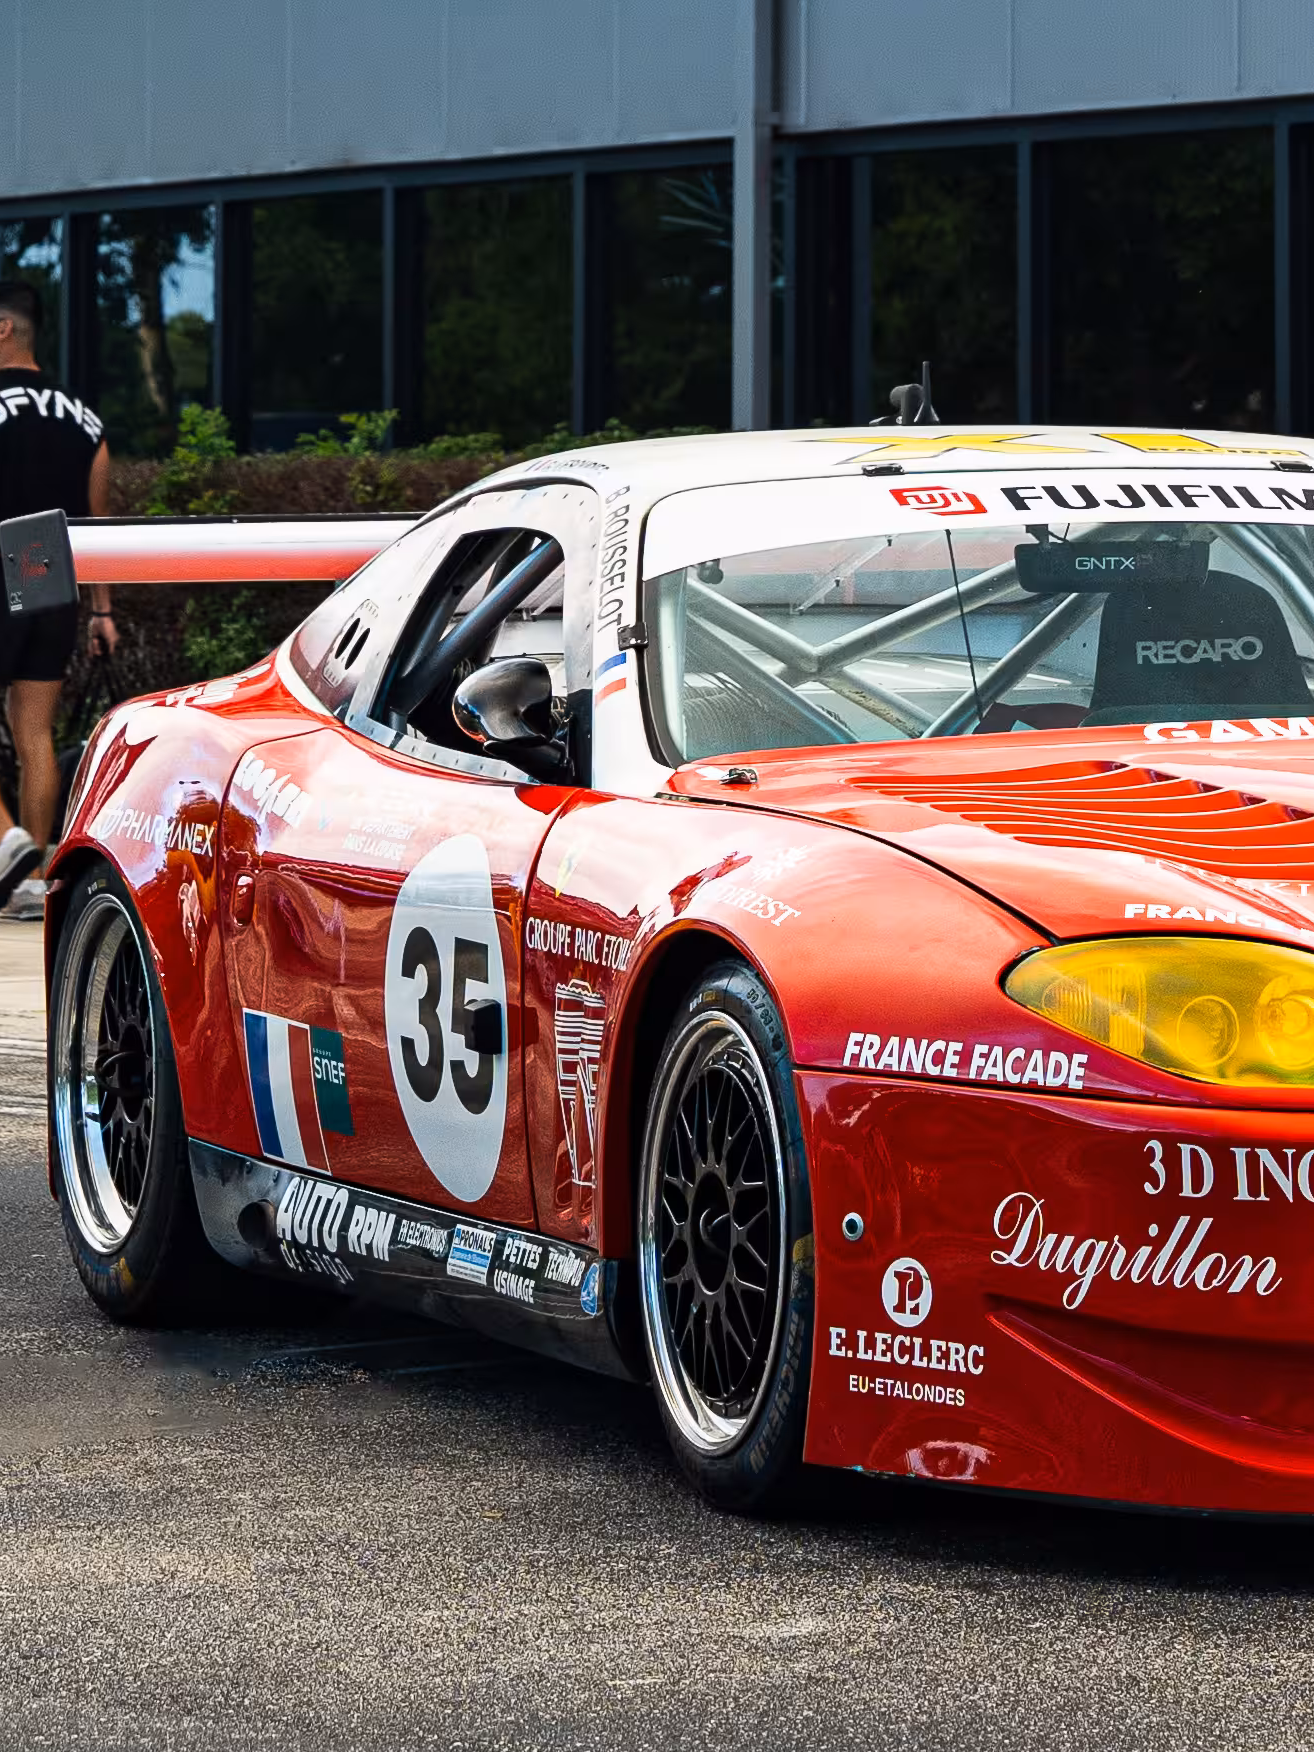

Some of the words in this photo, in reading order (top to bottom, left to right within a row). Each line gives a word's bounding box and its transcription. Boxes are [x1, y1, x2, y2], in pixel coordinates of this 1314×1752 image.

[1136, 636, 1264, 666] RECARO
[116, 807, 216, 858] PHARMANEX
[526, 916, 571, 953] GROUPE
[573, 927, 600, 965] PARC
[400, 926, 499, 1116] 35
[842, 1031, 964, 1078] FRANCE
[968, 1043, 1089, 1090] FACADE
[276, 1176, 349, 1253] AUTO
[347, 1204, 397, 1262] RPM
[502, 1236, 543, 1271] PETTES
[990, 1191, 1283, 1310] Dugrillon
[493, 1268, 536, 1304] USINAGE
[828, 1326, 985, 1376] E.LECLERC
[849, 1374, 966, 1407] EU-ETALONDES
